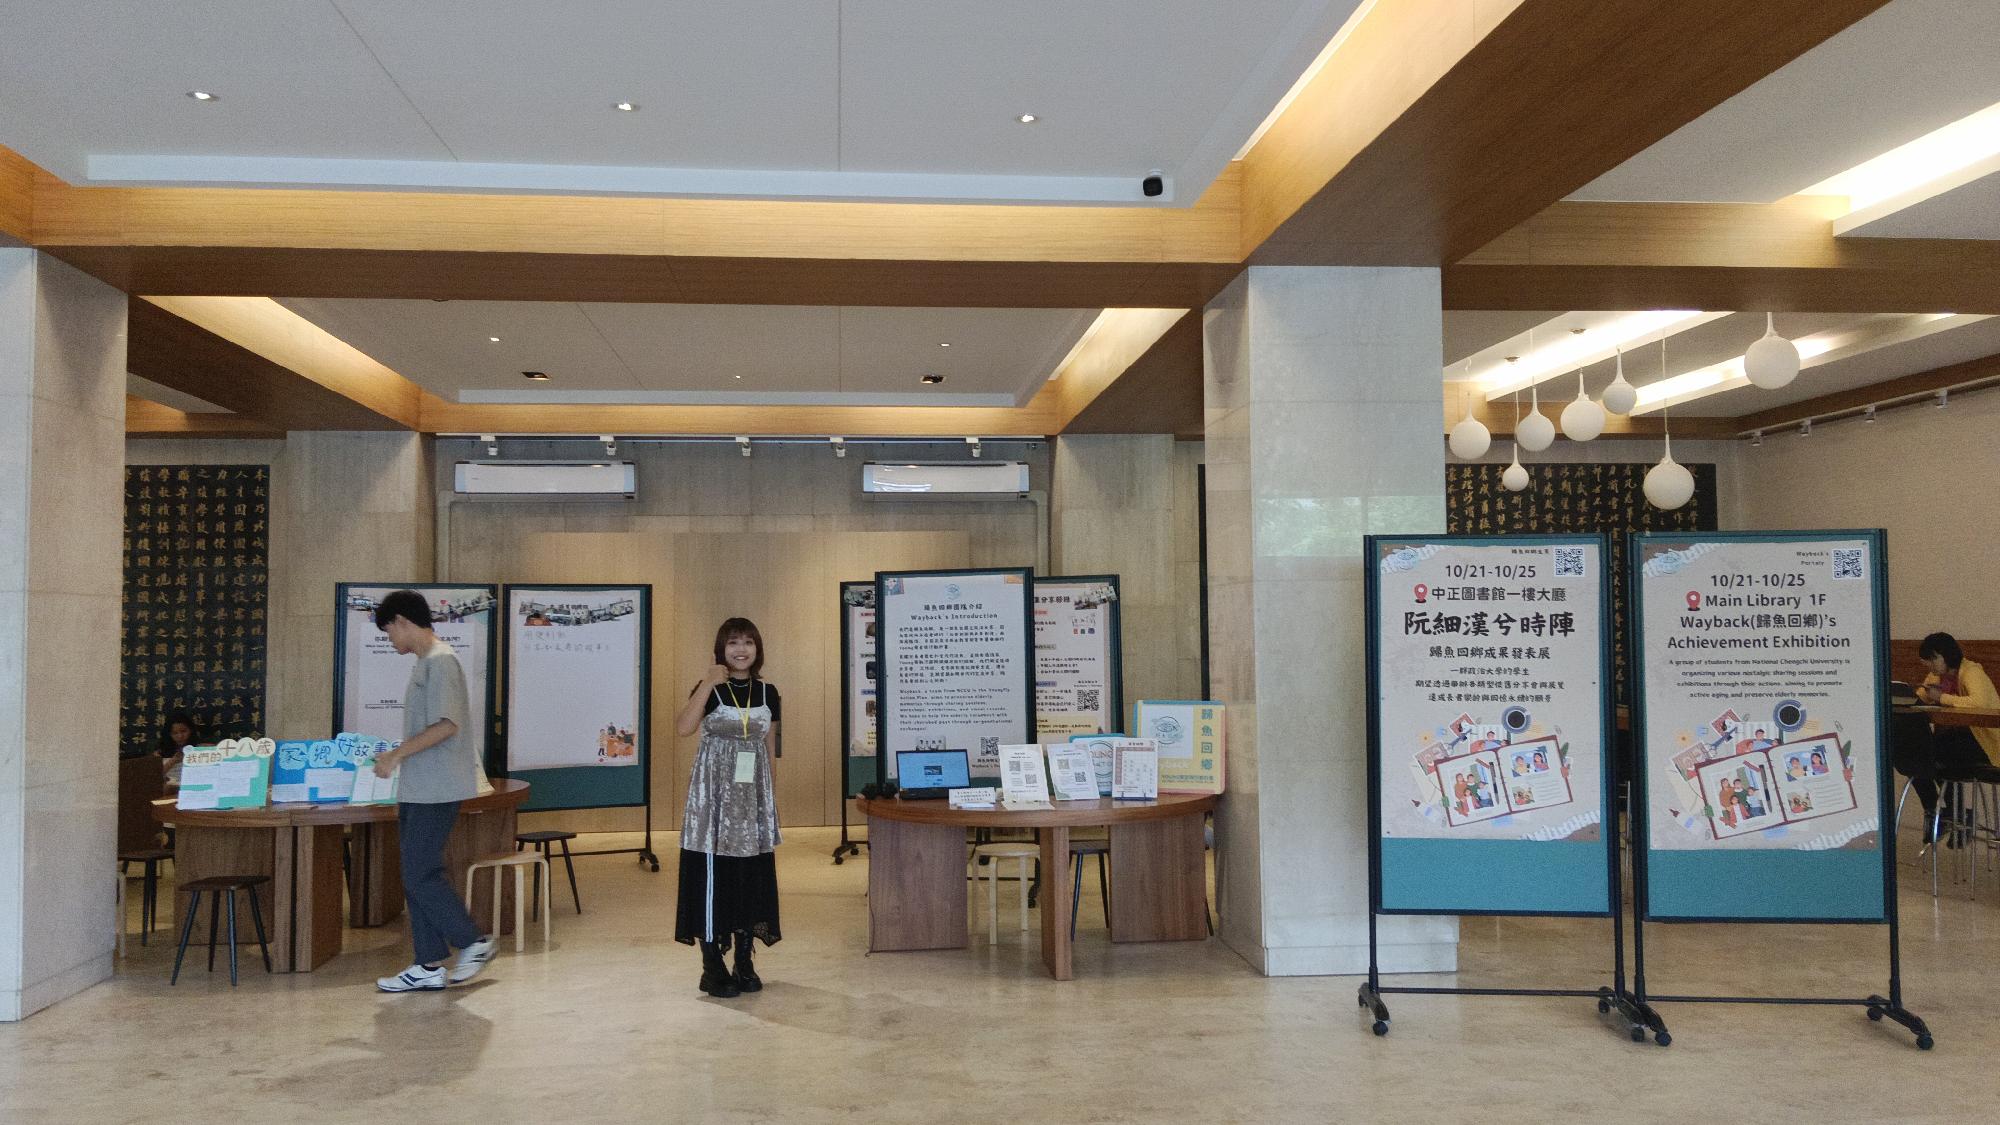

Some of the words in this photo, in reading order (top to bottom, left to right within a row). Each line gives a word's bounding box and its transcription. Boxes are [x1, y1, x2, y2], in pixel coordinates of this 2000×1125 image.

[1445, 564, 1536, 580] 10/21-10/25
[1710, 573, 1806, 589] 10/21-10/25
[1432, 586, 1567, 602] 中正圖書館一樓大廳
[1706, 594, 1742, 607] Main
[1747, 594, 1801, 610] Library
[1809, 594, 1827, 606] 1F
[1404, 611, 1575, 637] 阮細漢兮時陣
[1667, 636, 1768, 650] Achievement
[1772, 634, 1850, 648] Exhibition
[1429, 646, 1551, 660] 歸魚回鄉成果發表展
[1780, 658, 1808, 666] Chengchi
[1810, 658, 1842, 666] University
